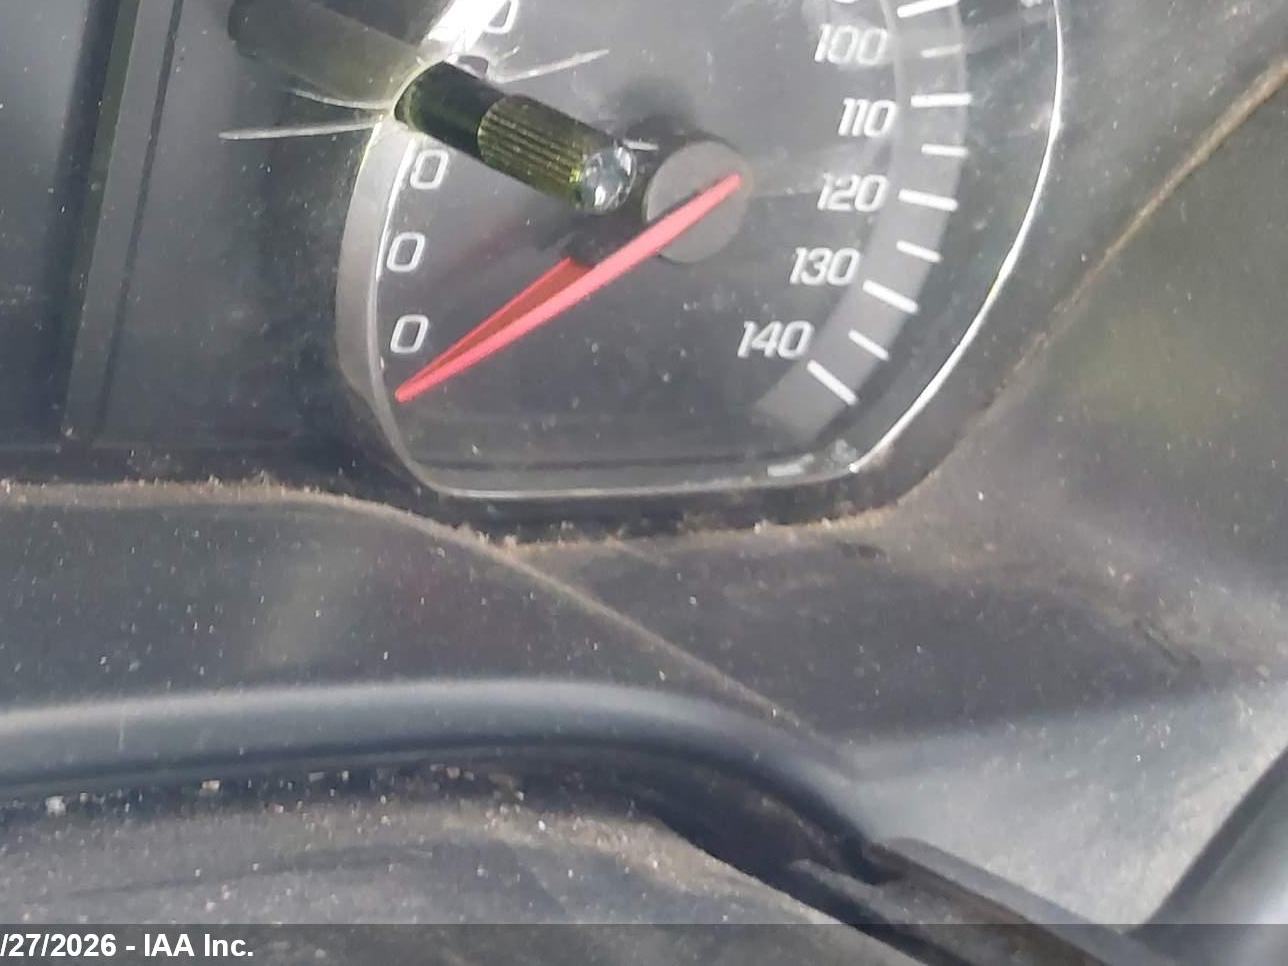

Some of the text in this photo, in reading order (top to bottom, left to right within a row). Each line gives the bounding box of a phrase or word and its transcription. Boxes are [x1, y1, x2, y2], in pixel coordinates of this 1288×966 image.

[815, 23, 887, 66] 100
[838, 97, 896, 139] 110
[817, 172, 887, 212] 120
[789, 247, 861, 286] 130
[737, 320, 815, 360] 140
